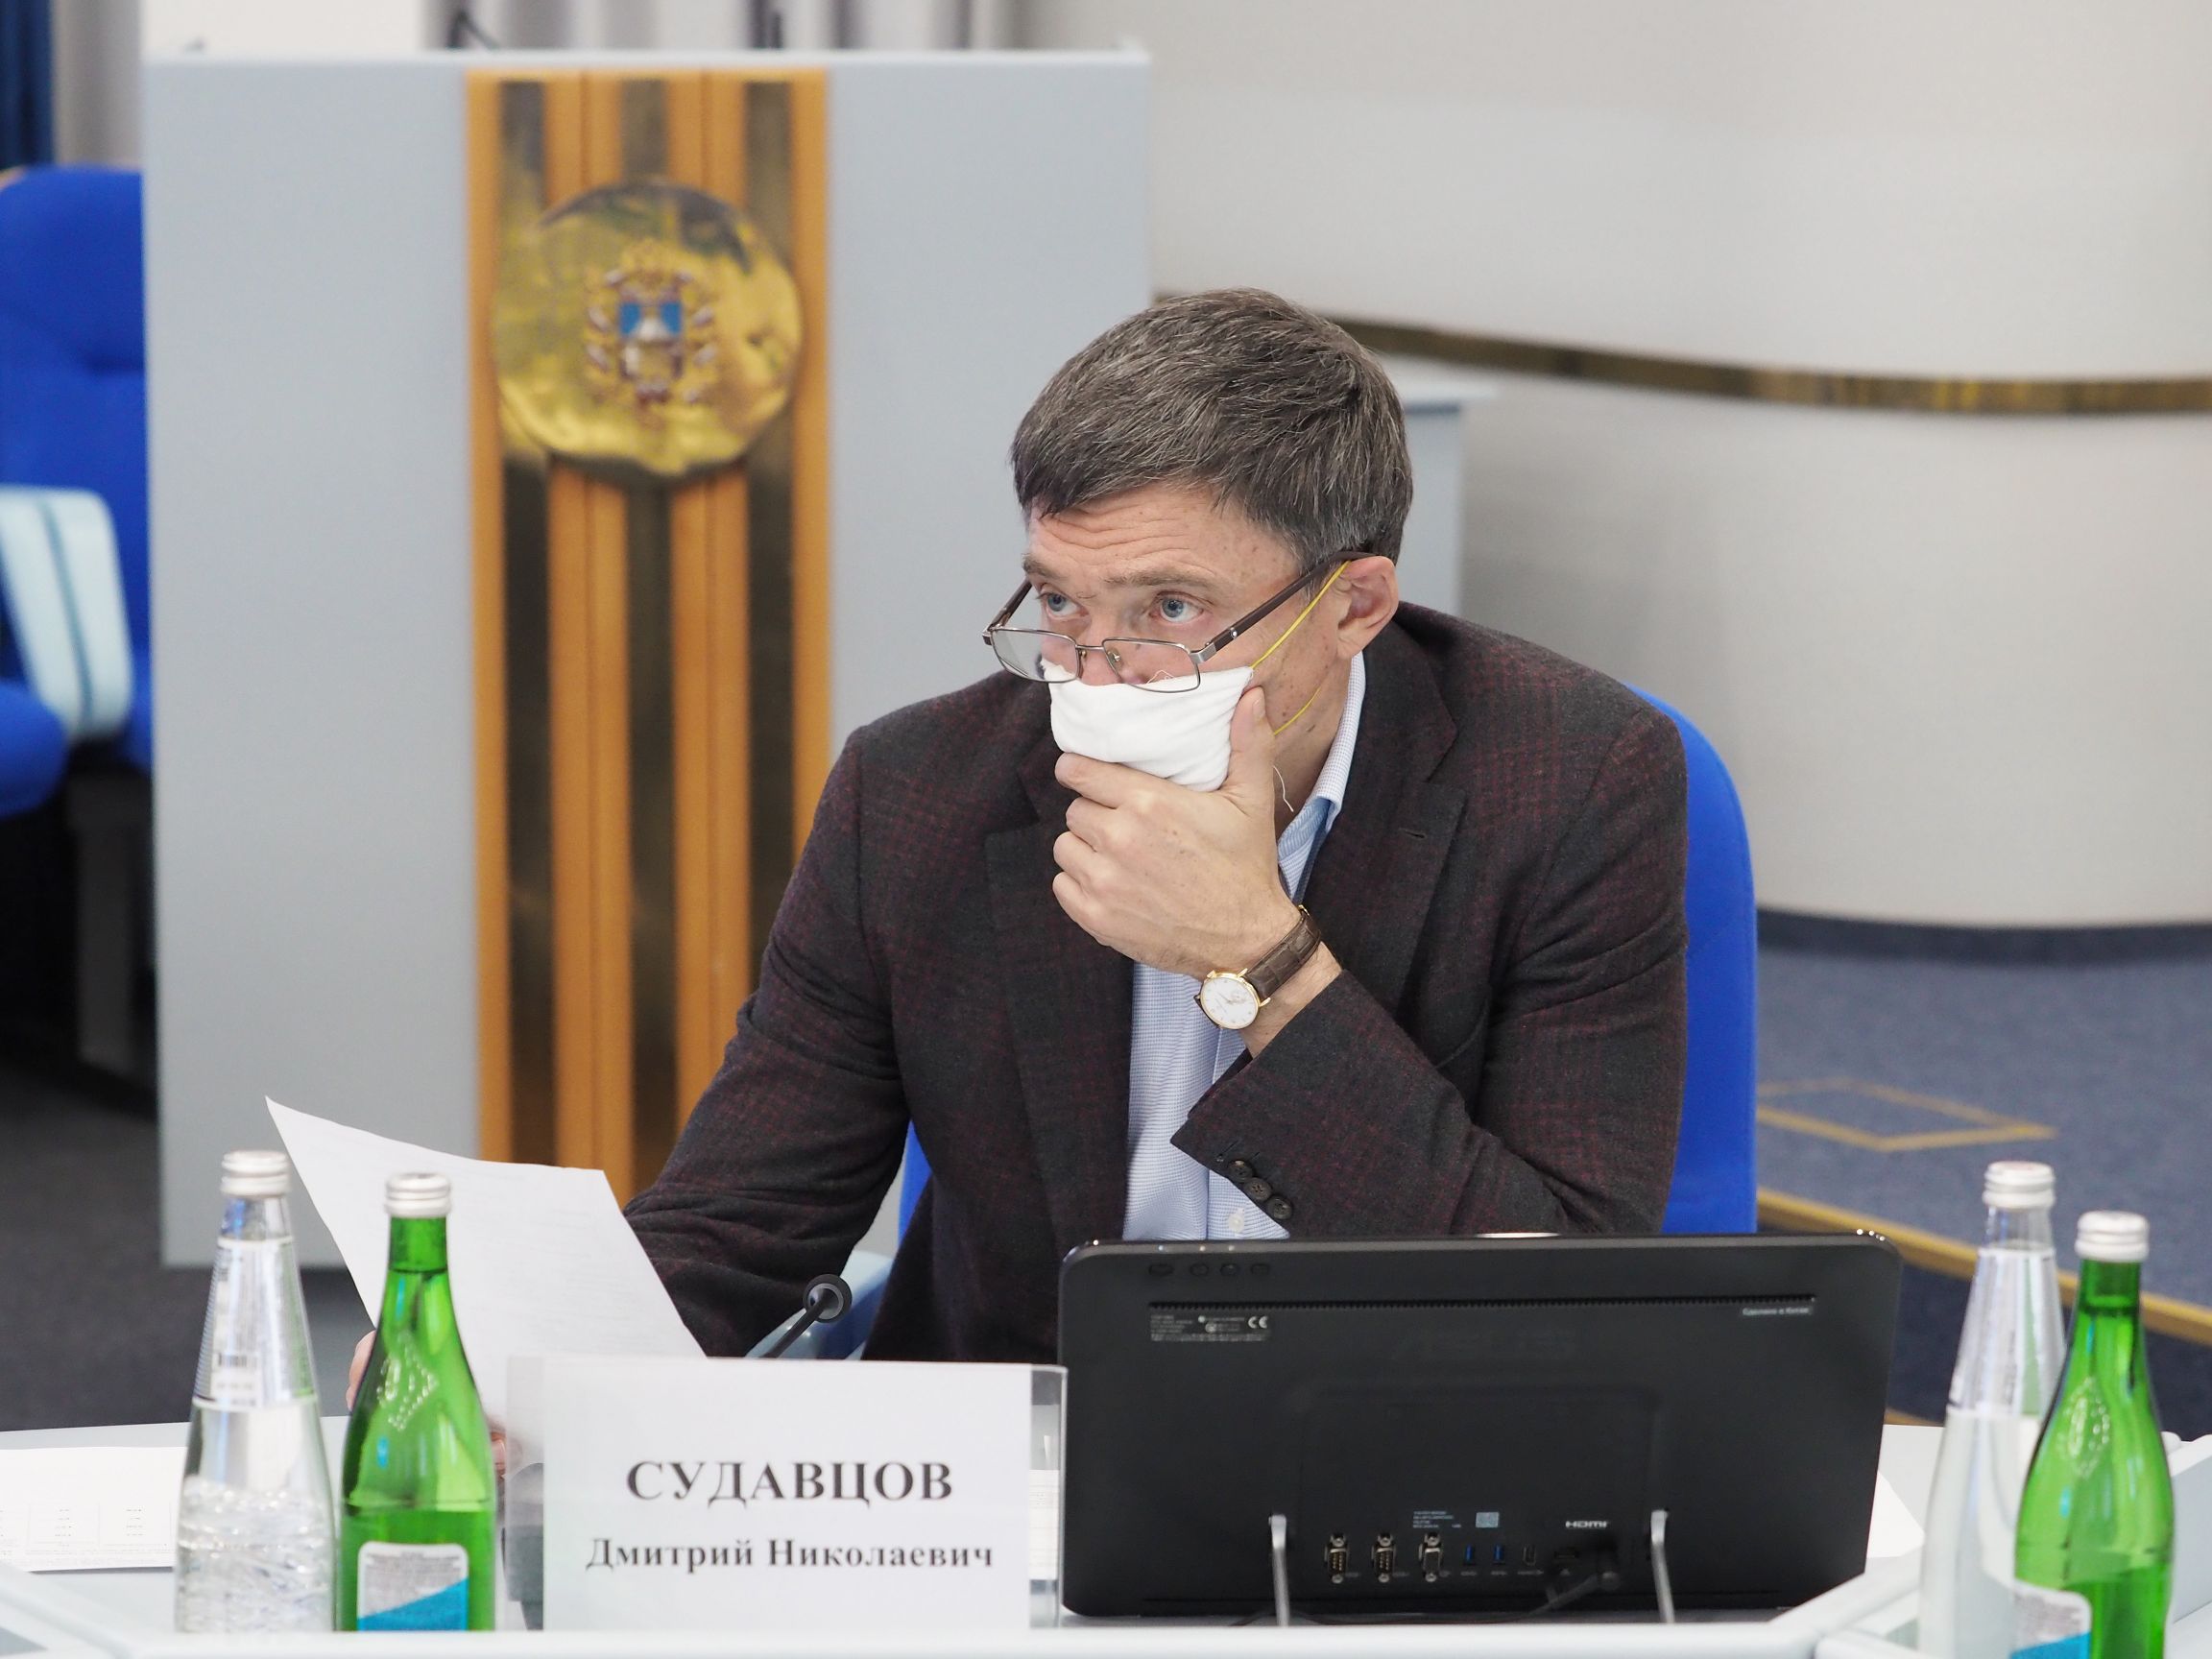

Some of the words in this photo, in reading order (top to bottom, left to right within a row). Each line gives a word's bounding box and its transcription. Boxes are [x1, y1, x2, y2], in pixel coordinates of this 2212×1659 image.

[626, 1460, 953, 1508] СУДАВЦОВ
[585, 1538, 754, 1575] Дмитрий
[768, 1539, 993, 1568] Николаевич
